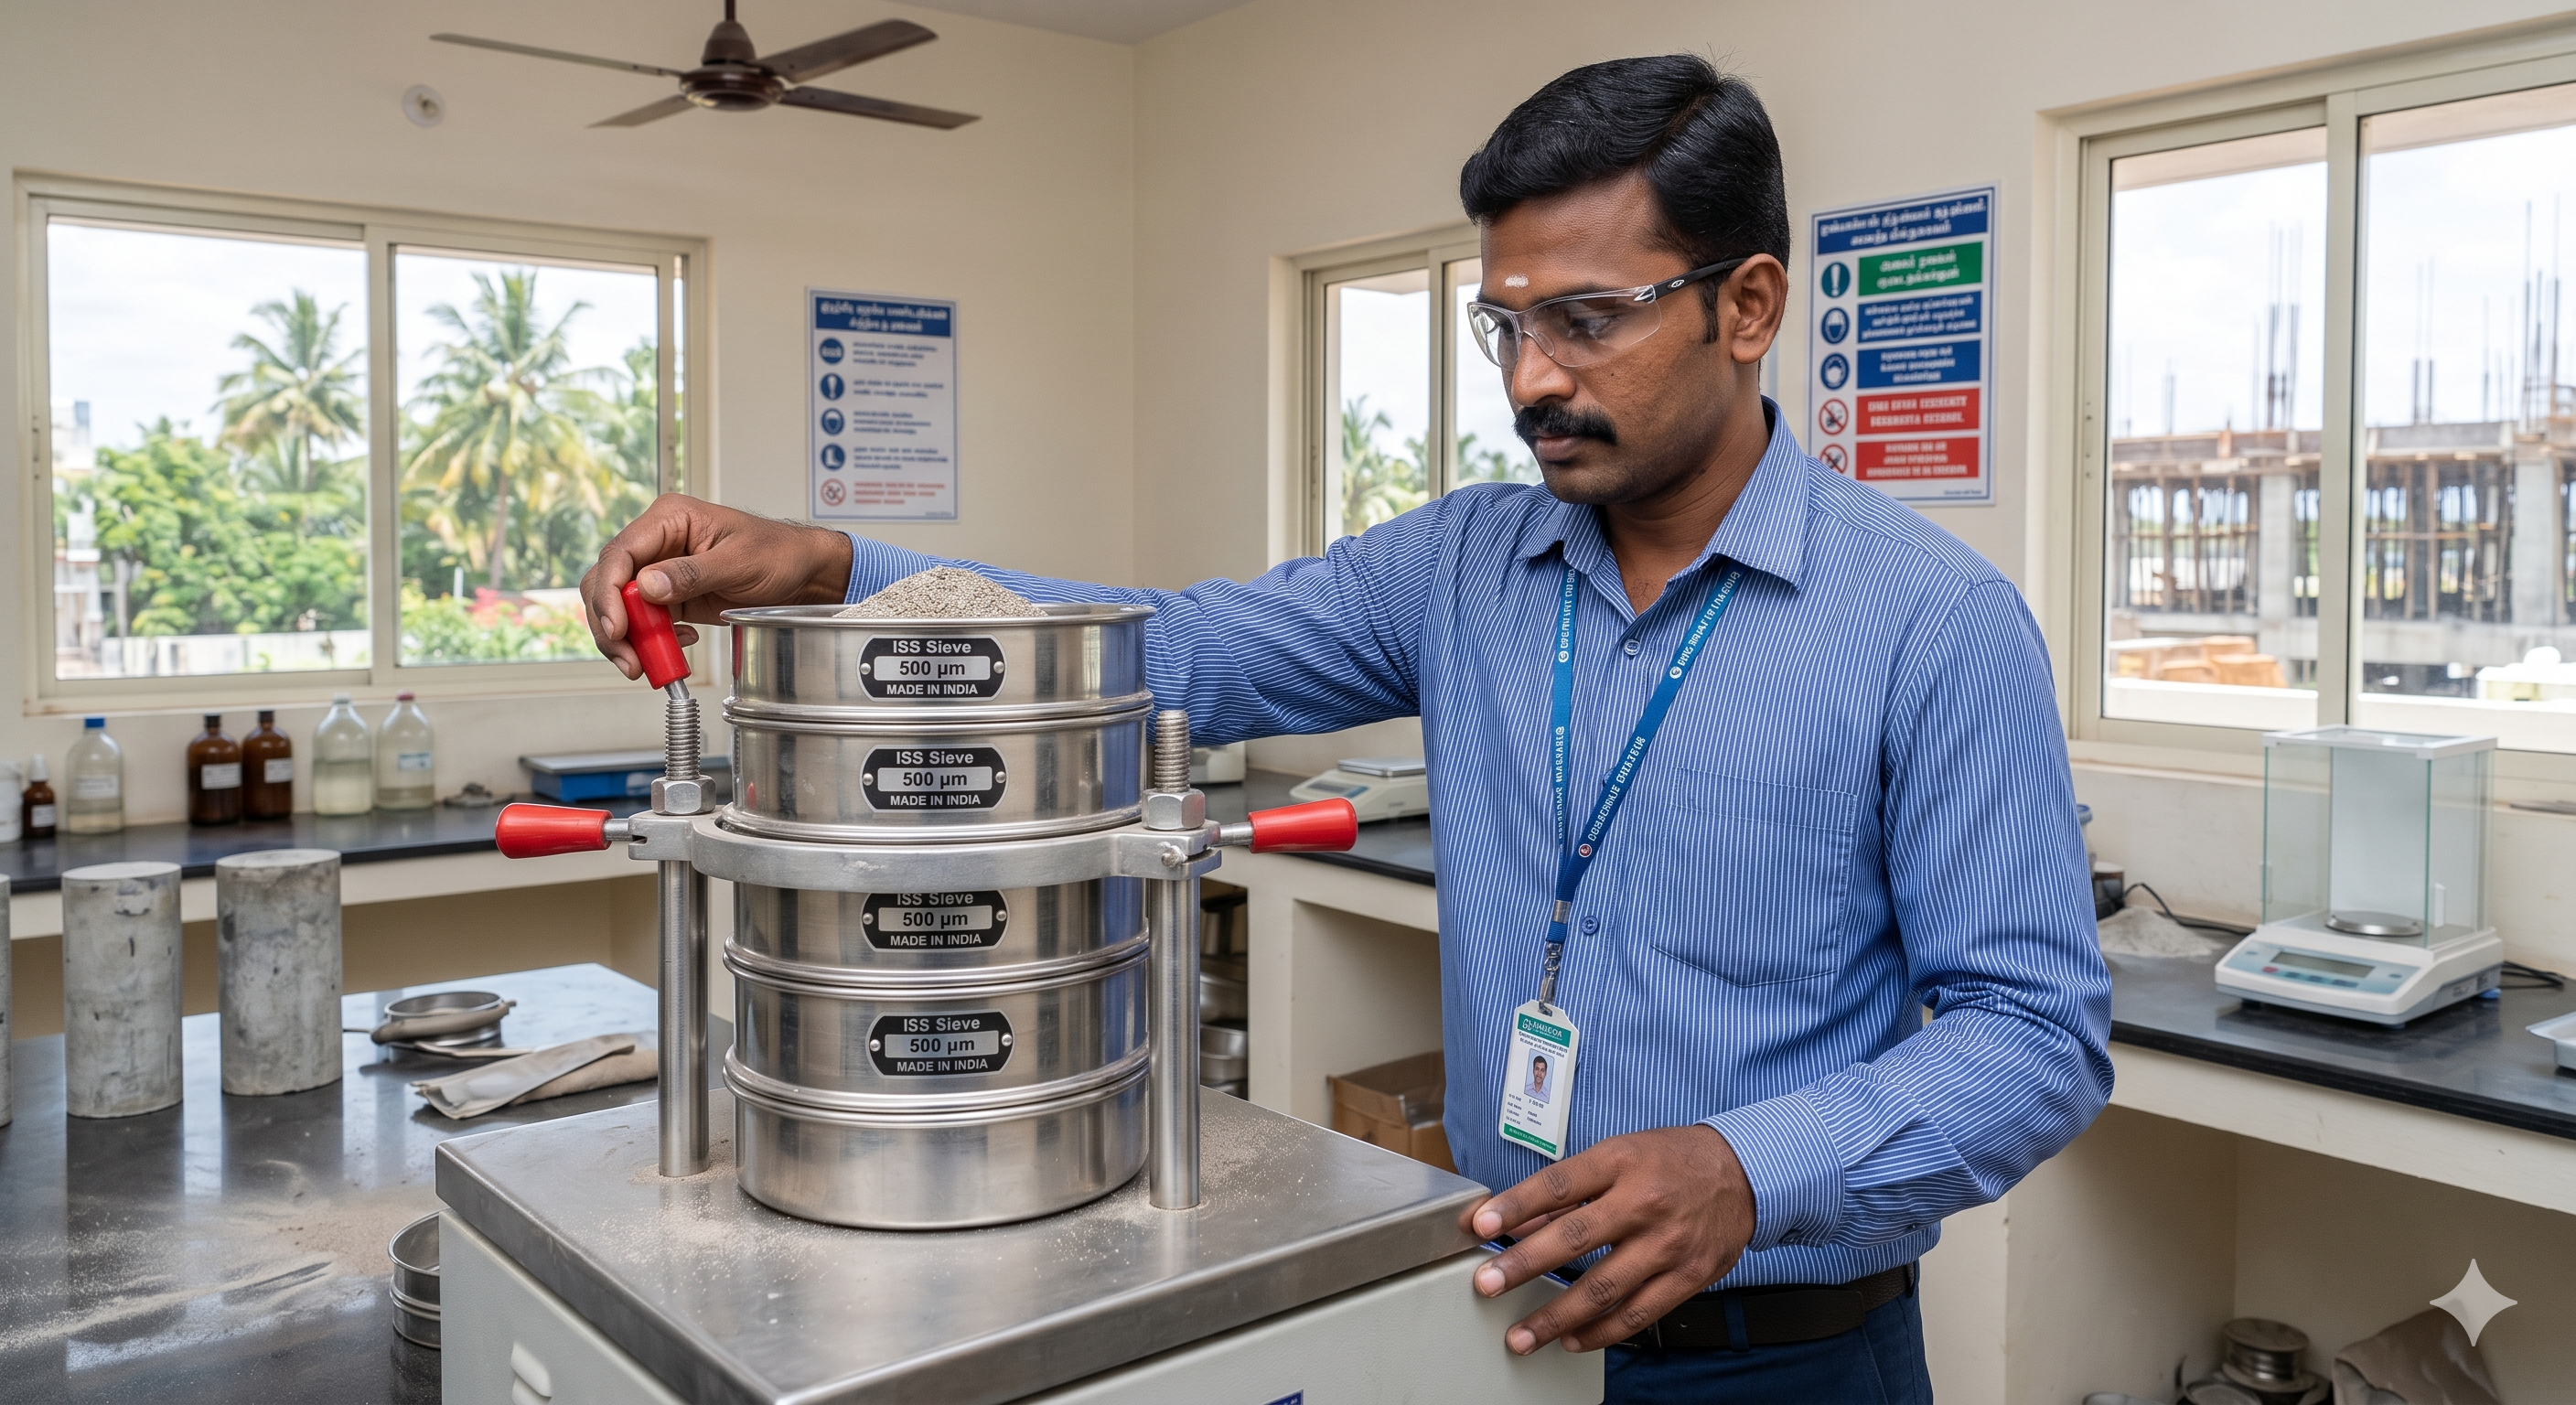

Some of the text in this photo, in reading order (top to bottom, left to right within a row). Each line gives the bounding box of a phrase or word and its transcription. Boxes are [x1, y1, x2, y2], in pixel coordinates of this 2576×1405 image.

[893, 640, 971, 653] ISS Sieve
[899, 660, 965, 679] 500 µm
[886, 684, 978, 694] MADE IN INDIA
[896, 751, 973, 765] ISS Sieve
[903, 772, 967, 789] 500 µm
[890, 795, 981, 805] MADE IN INDIA
[897, 893, 973, 906] ISS Sieve
[903, 912, 968, 929] 500 µm
[890, 934, 982, 946] MADE IN INDIA
[904, 1017, 980, 1032] ISS Sieve
[910, 1038, 974, 1055] 500 µm
[896, 1058, 988, 1072] MADE IN INDIA
